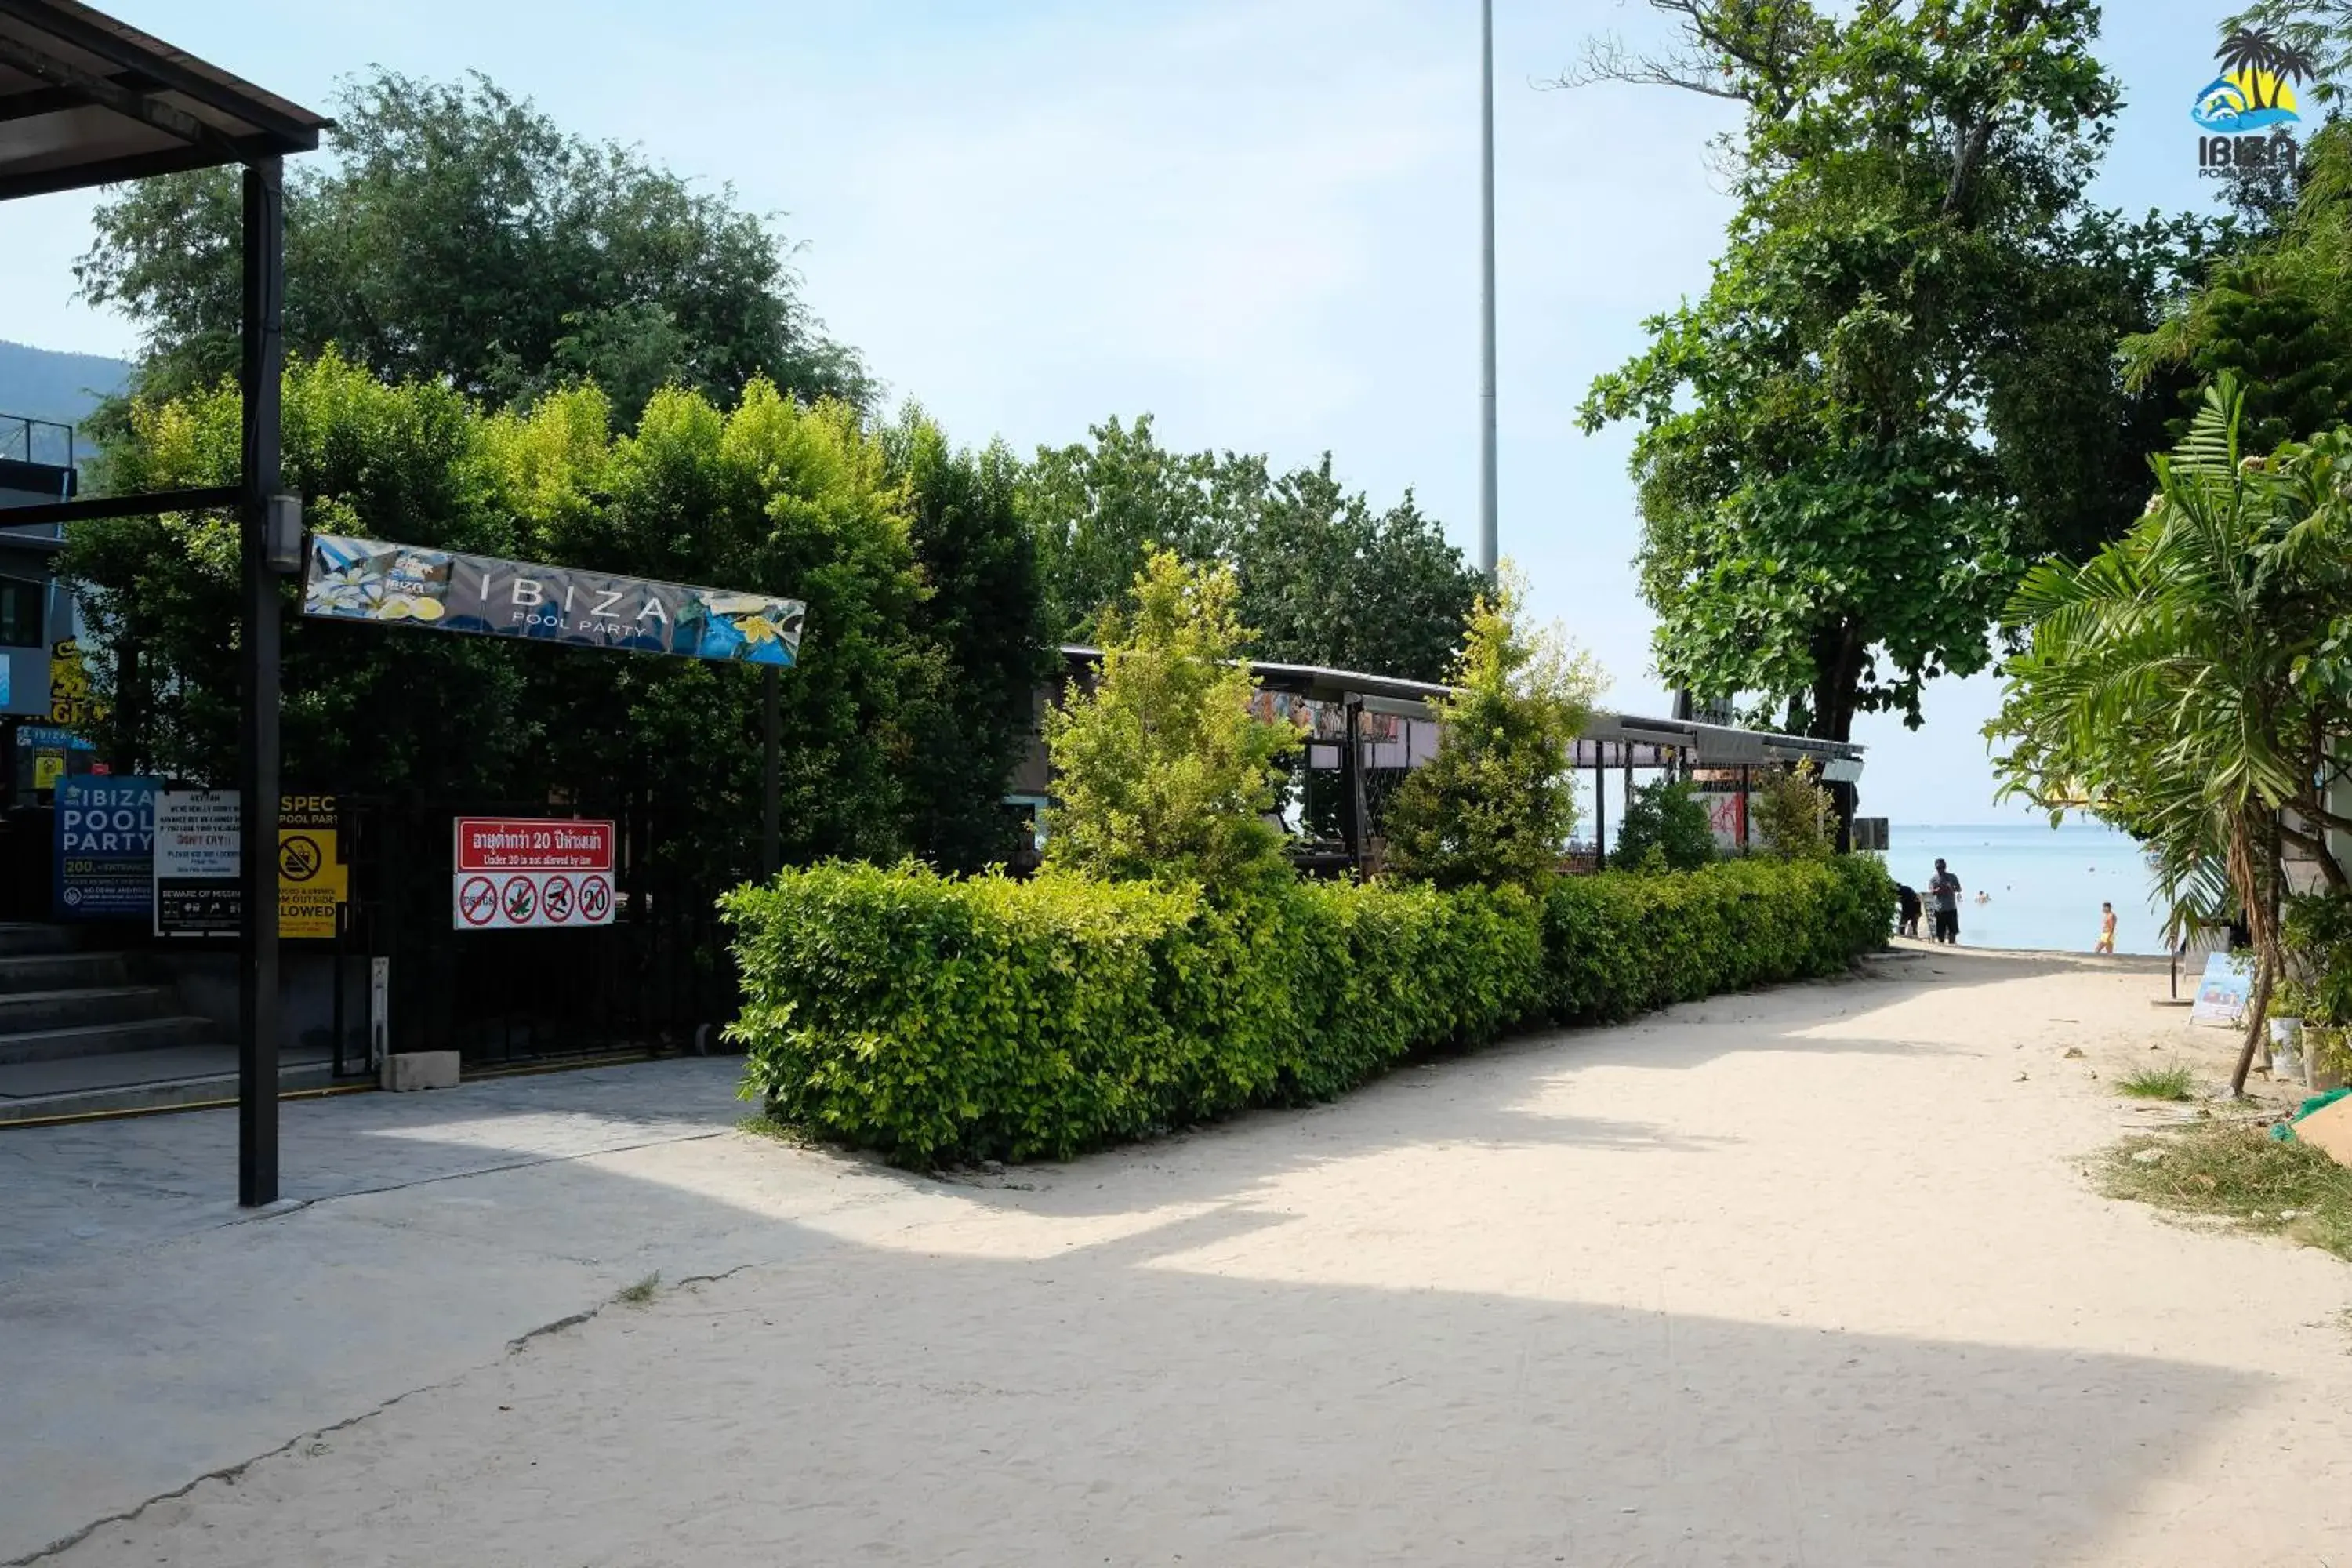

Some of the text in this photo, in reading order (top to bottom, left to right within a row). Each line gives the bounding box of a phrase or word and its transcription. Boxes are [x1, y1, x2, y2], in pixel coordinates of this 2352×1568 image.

[480, 574, 669, 625] IBIZA
[511, 611, 647, 637] POOL PARTY
[82, 789, 153, 807] IBIZA
[281, 794, 336, 812] SPEC
[63, 809, 153, 831] POOL
[63, 832, 153, 851] PARTY
[473, 823, 529, 855] อายุต่ำกว่า
[532, 832, 551, 850] 20
[483, 855, 506, 865] Under
[508, 855, 519, 865] 20
[520, 855, 527, 865] is
[543, 855, 568, 865] allowed
[570, 855, 578, 867] by
[280, 905, 335, 916] LOWED
